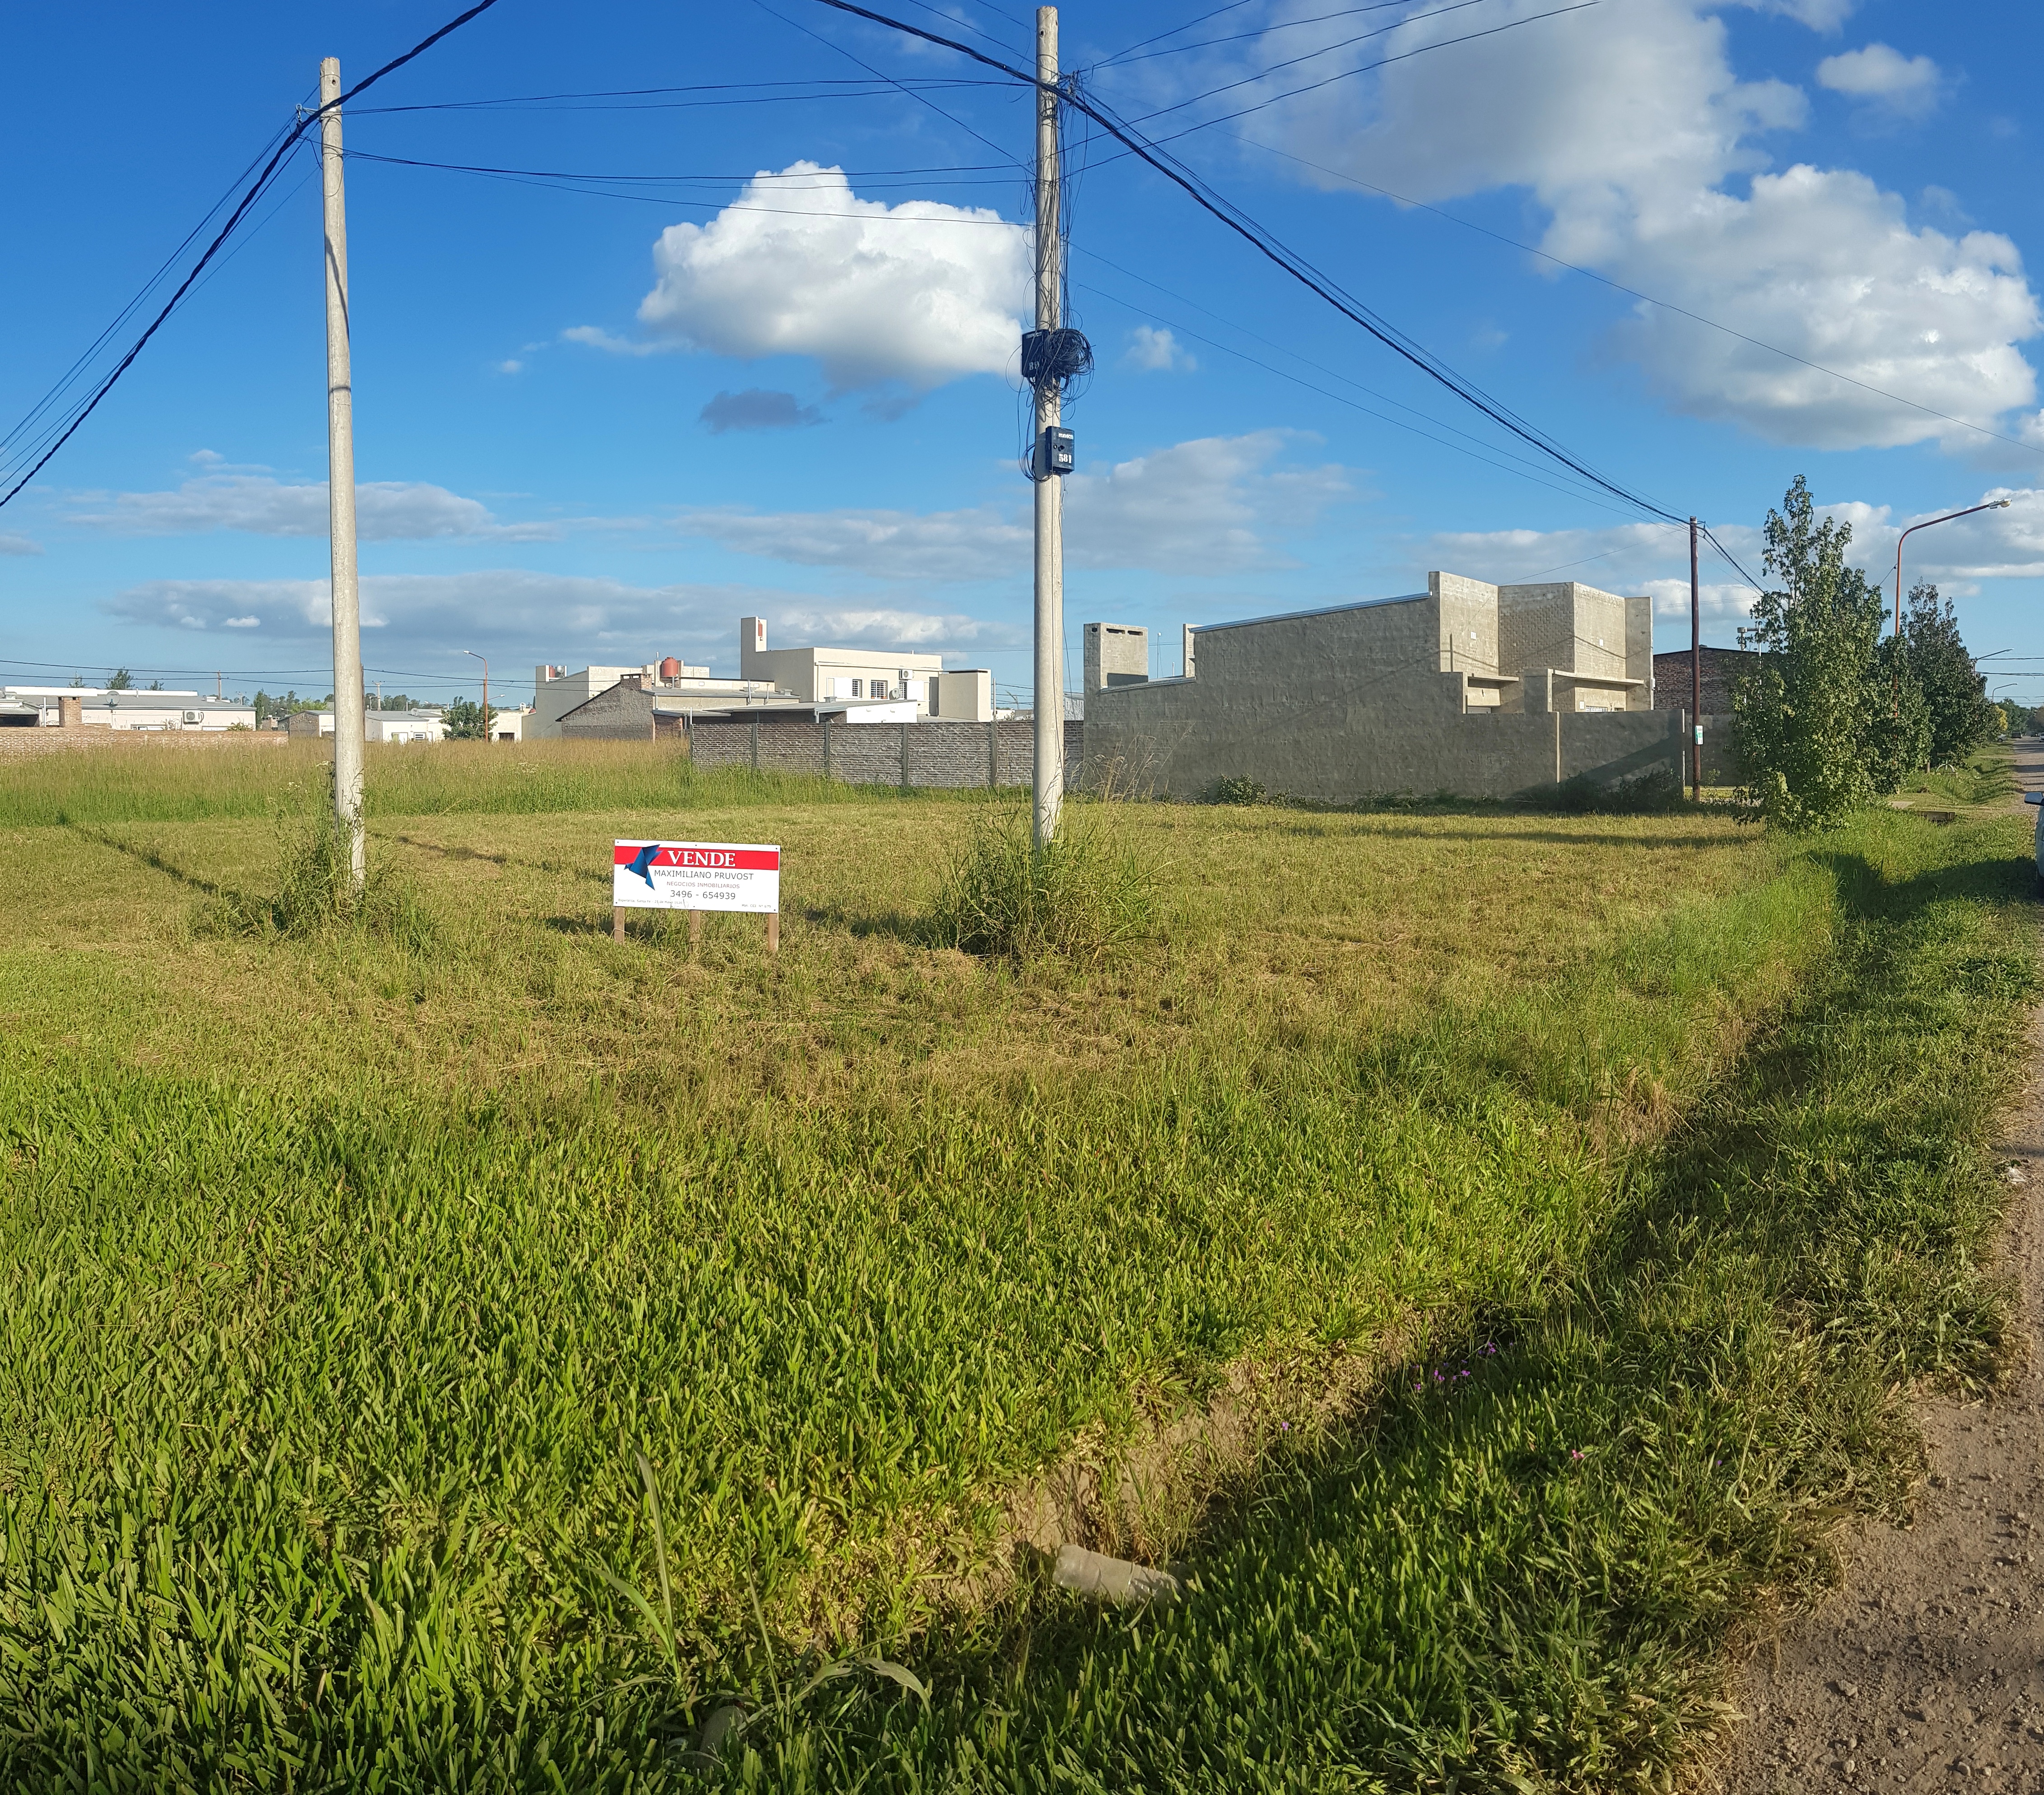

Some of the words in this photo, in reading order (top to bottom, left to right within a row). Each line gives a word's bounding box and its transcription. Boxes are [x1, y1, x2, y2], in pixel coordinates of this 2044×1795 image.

[1058, 453, 1072, 464] 581
[667, 850, 736, 867] VENDE
[654, 870, 712, 879] MAXIMILIANO
[714, 872, 754, 880] PRUVOST
[670, 890, 692, 898] 3496
[703, 892, 736, 900] 654939
